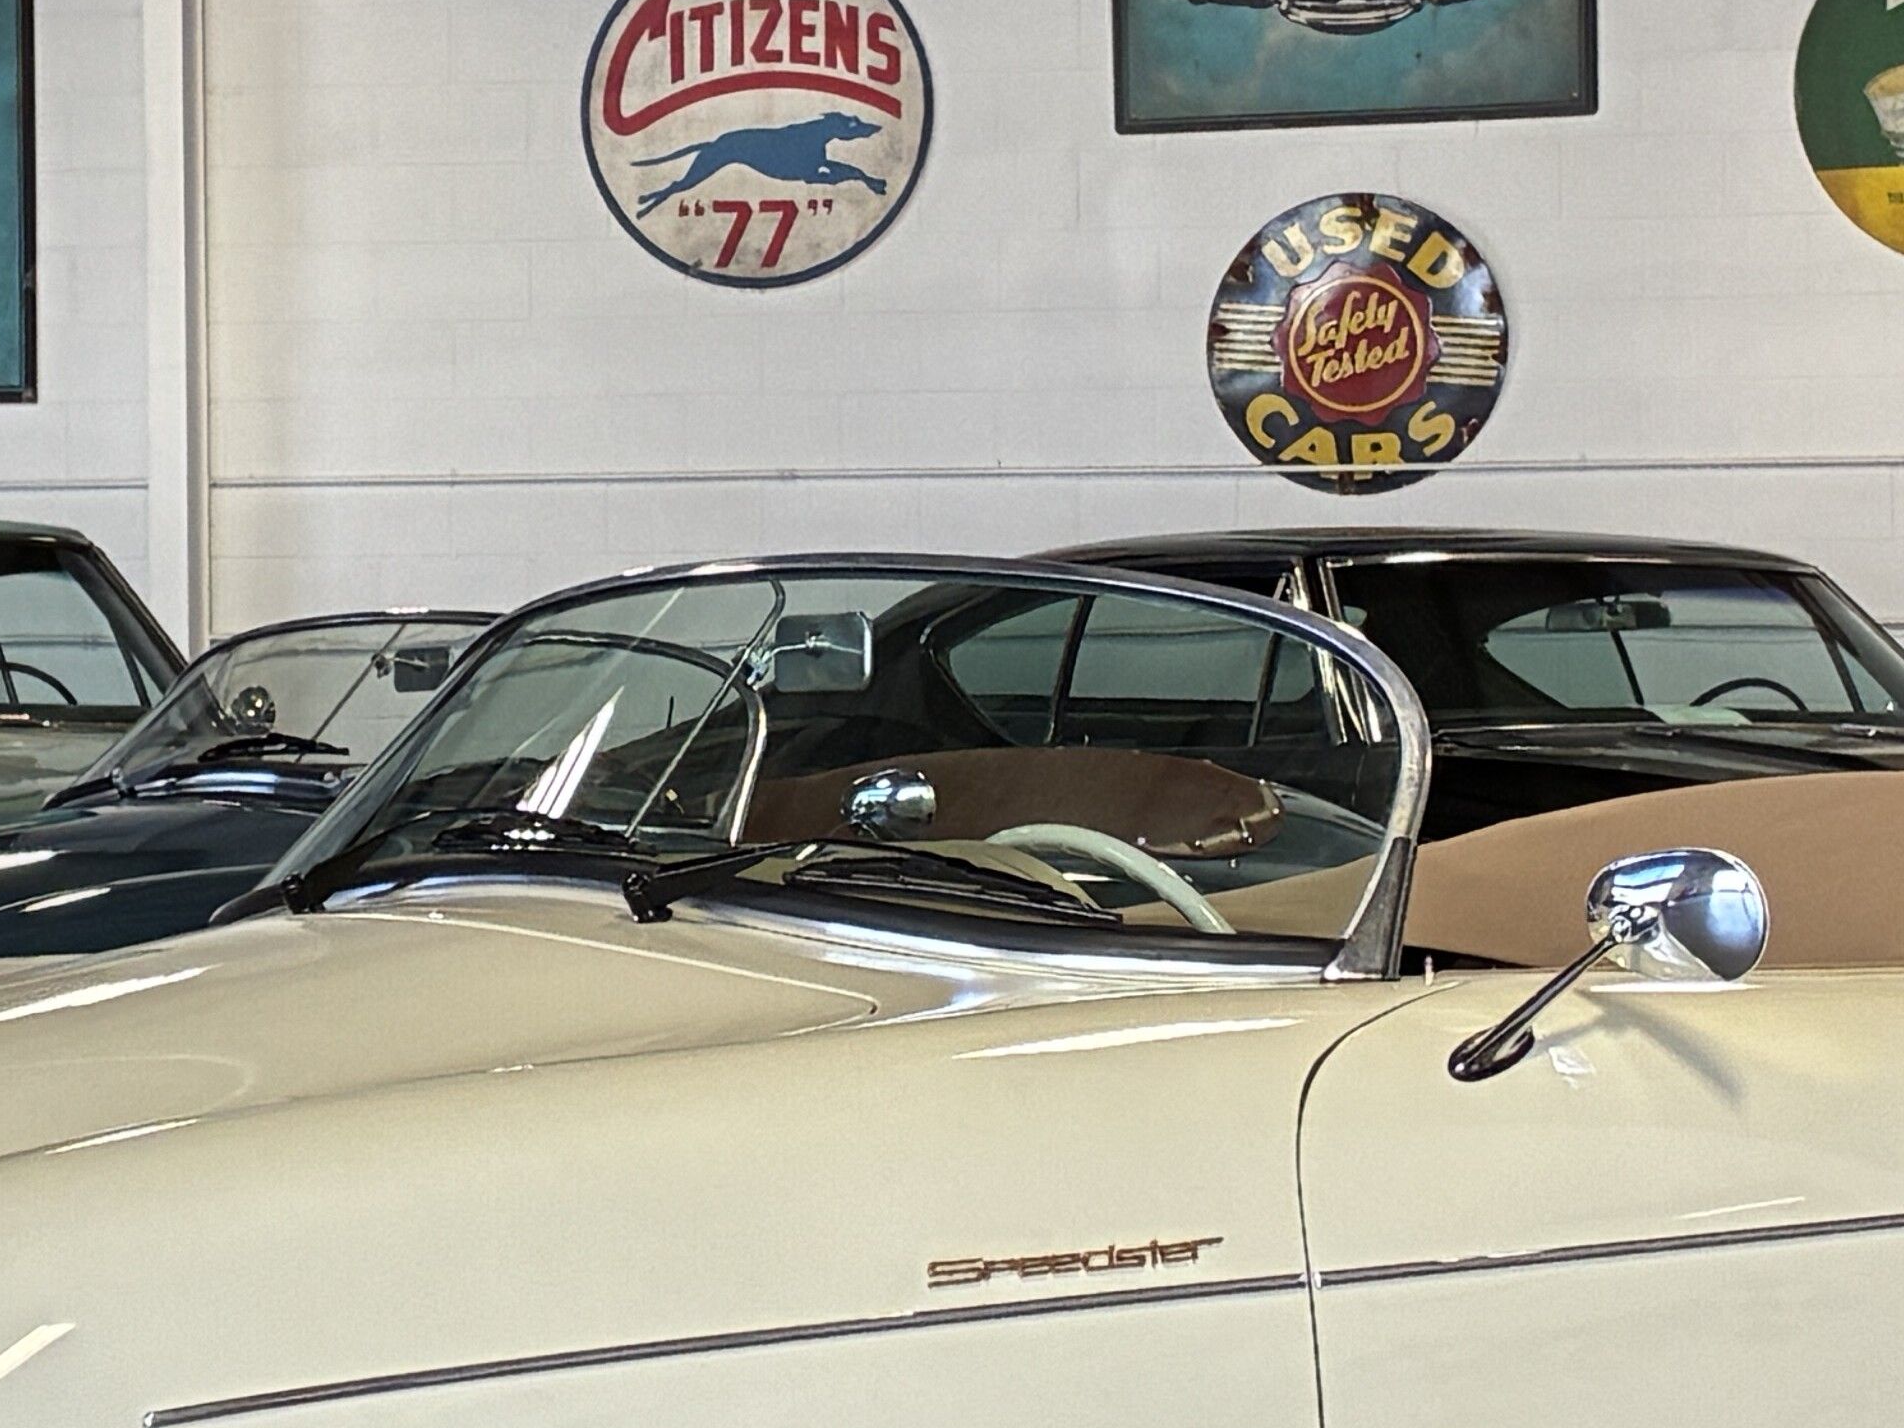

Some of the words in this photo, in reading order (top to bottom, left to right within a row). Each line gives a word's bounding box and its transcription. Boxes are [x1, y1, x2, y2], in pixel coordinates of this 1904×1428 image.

[1261, 205, 1465, 289] USED
[1297, 290, 1399, 357] Safety
[1305, 326, 1411, 389] Tested
[1245, 393, 1456, 481] CARS
[926, 1235, 1224, 1290] Speedster
